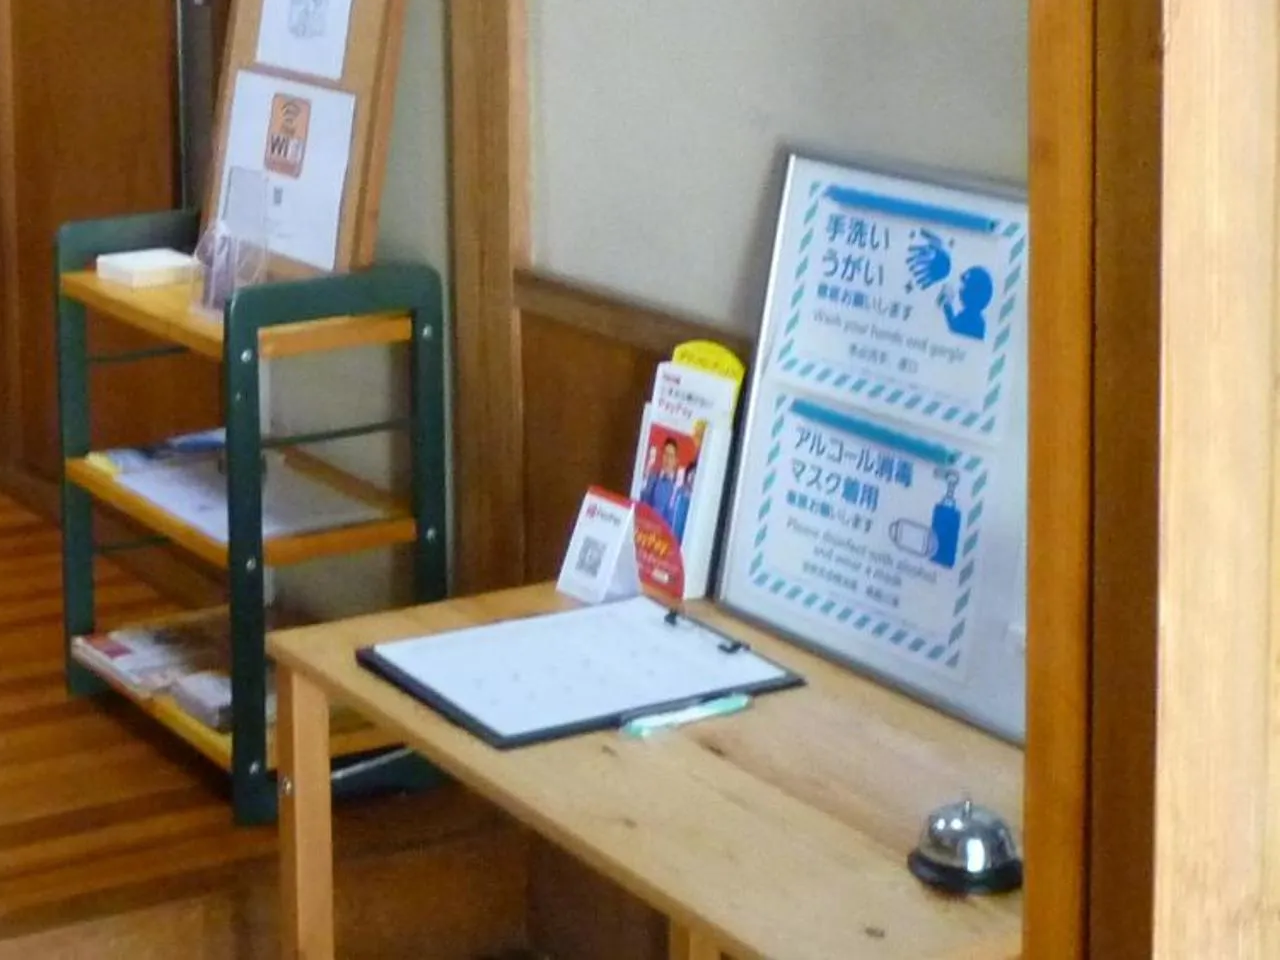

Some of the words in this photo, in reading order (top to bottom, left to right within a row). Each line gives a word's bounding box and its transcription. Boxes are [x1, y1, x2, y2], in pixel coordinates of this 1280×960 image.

[827, 215, 889, 248] 手洗い
[823, 250, 883, 286] うがい
[797, 426, 913, 488] アルコール消毒
